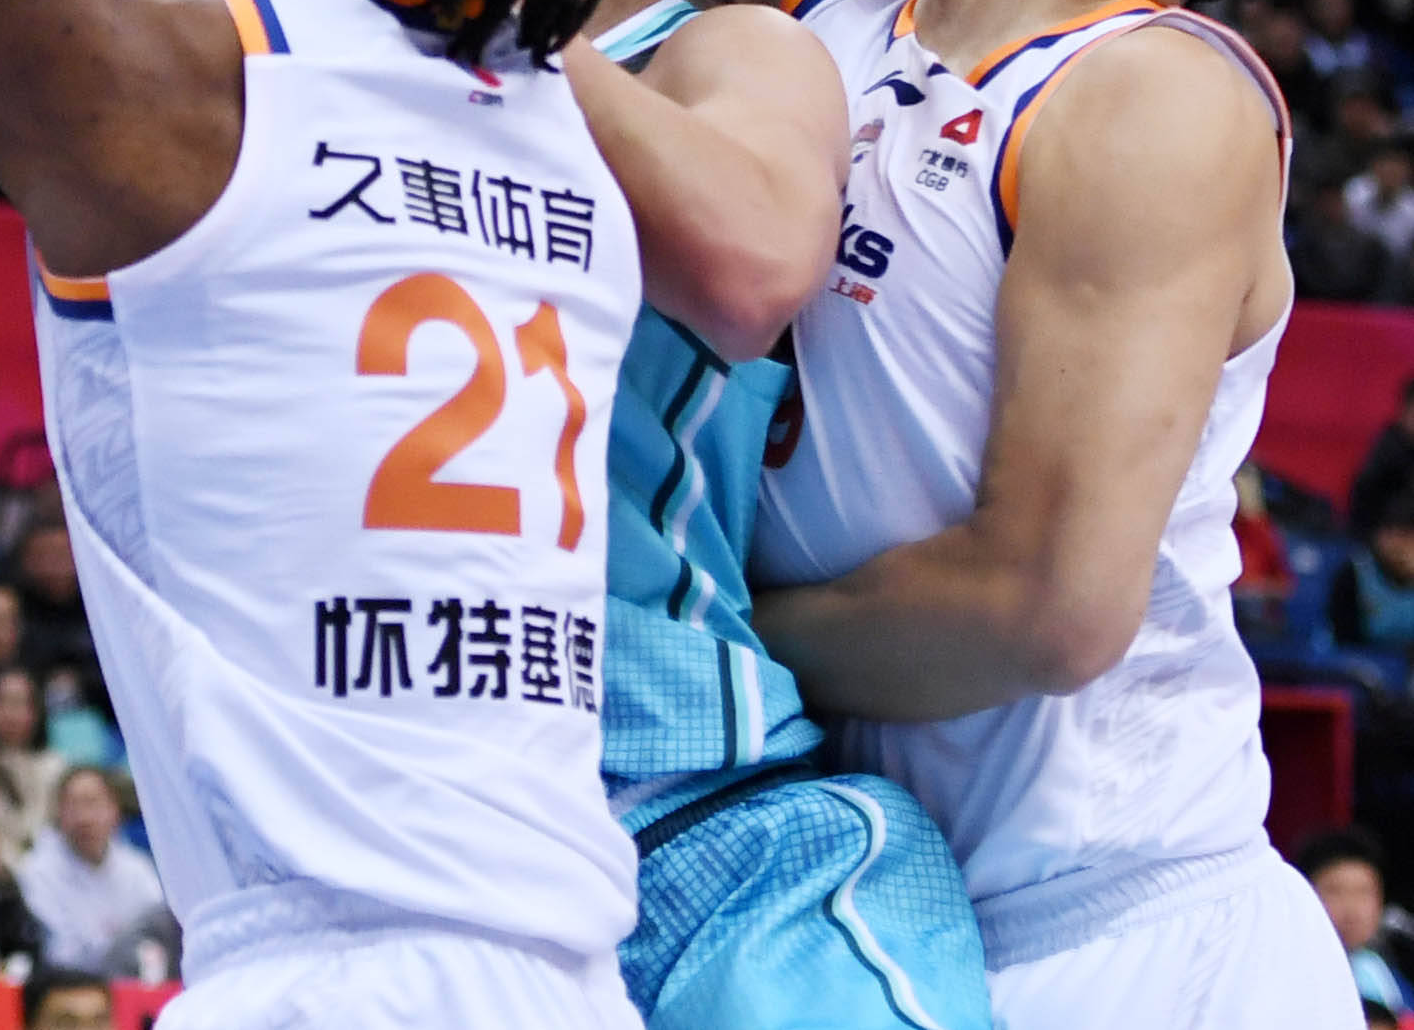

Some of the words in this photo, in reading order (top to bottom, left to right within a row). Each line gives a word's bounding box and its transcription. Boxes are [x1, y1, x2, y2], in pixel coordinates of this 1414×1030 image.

[308, 141, 595, 272] 久事体育
[915, 169, 950, 192] CGB
[355, 271, 587, 553] 21
[314, 596, 600, 714] 怀特塞德
